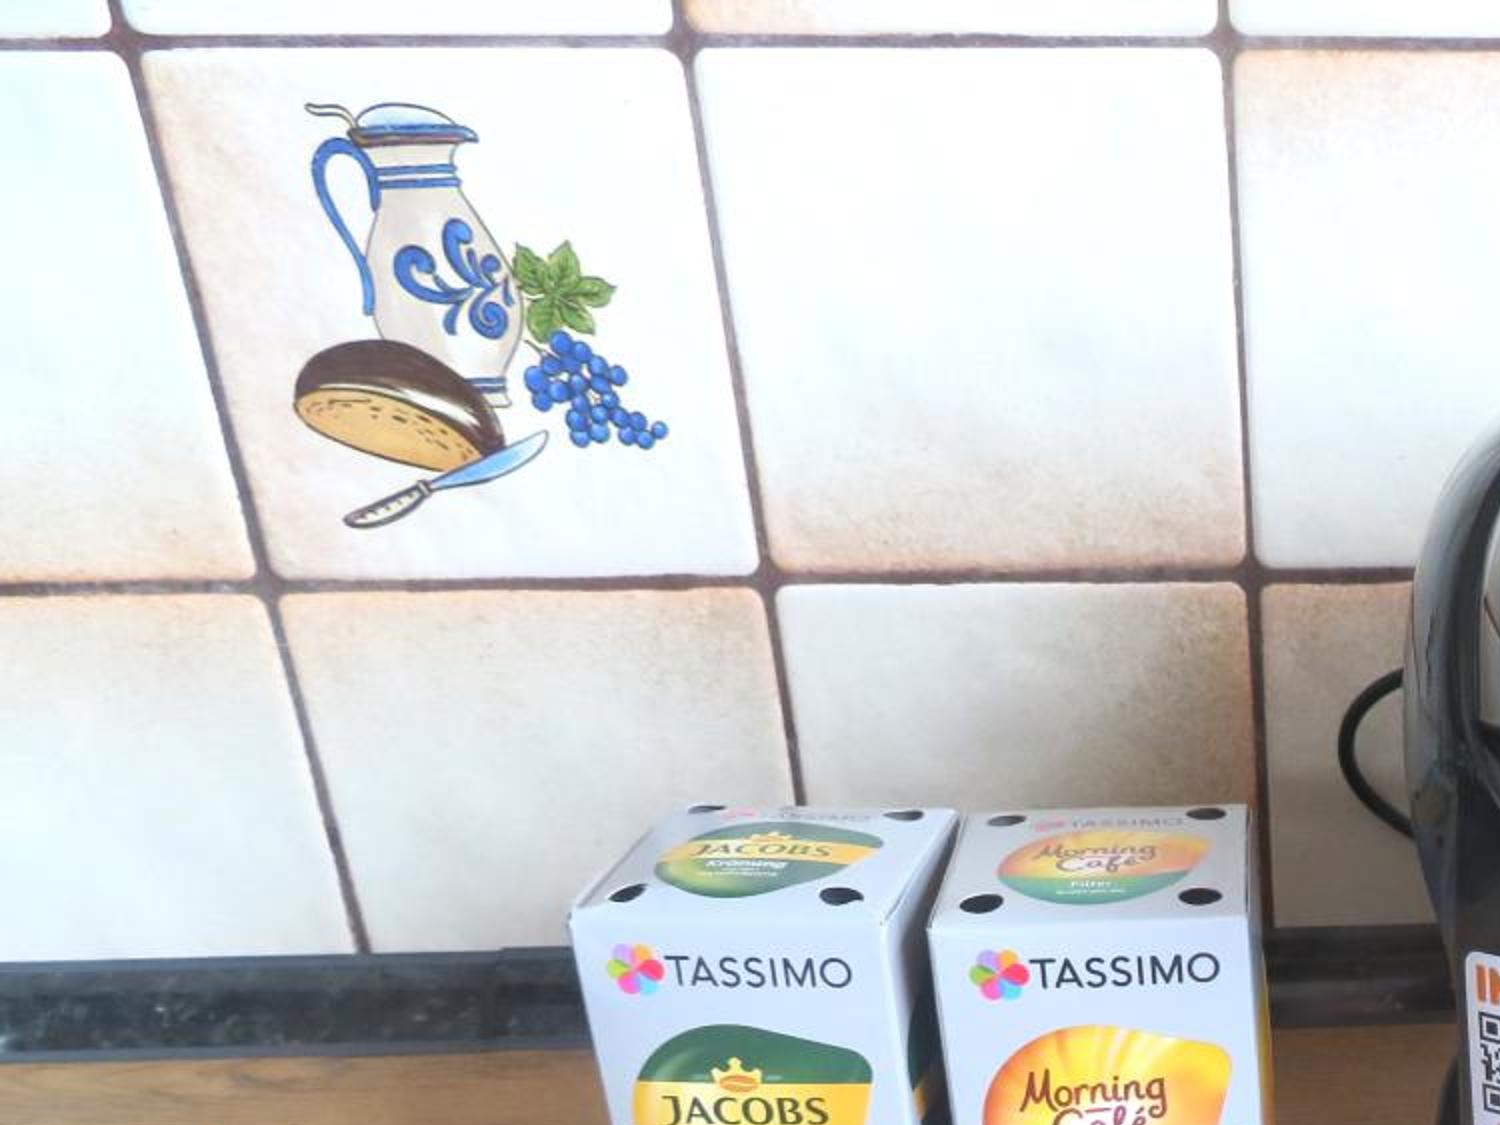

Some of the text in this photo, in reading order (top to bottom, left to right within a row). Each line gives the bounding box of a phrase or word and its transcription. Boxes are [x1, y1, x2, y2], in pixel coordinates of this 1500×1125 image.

[664, 954, 853, 989] TASSIMO
[1029, 951, 1221, 989] TASSIMO
[1019, 1068, 1169, 1118] Morning
